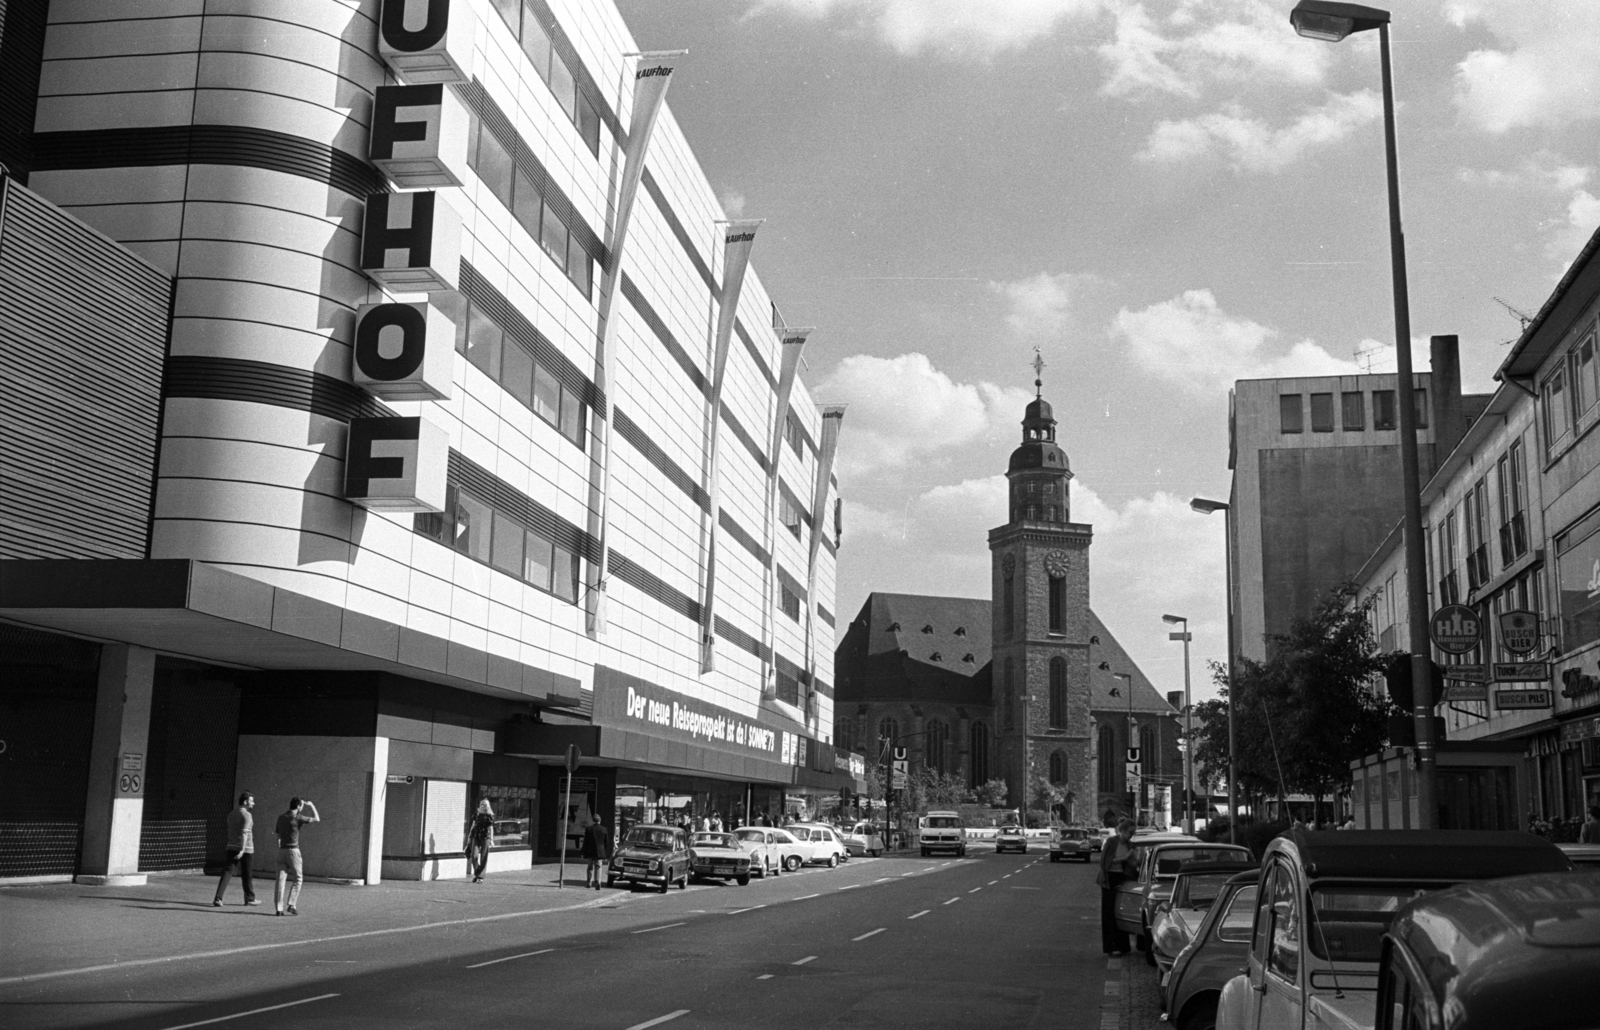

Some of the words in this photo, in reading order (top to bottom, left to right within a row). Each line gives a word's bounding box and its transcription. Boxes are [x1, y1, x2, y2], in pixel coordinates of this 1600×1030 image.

[1505, 629, 1535, 639] BUSCH
[1437, 635, 1477, 644] Henninger
[1511, 638, 1532, 648] BIER
[1449, 642, 1467, 650] Bier
[1499, 694, 1527, 704] BUSCH
[1528, 694, 1545, 703] PILS
[627, 687, 647, 719] Der
[648, 699, 671, 726] neue
[672, 702, 726, 742] Reiseprospekt
[726, 719, 735, 742] ist
[894, 747, 907, 760] U
[1127, 748, 1140, 762] U
